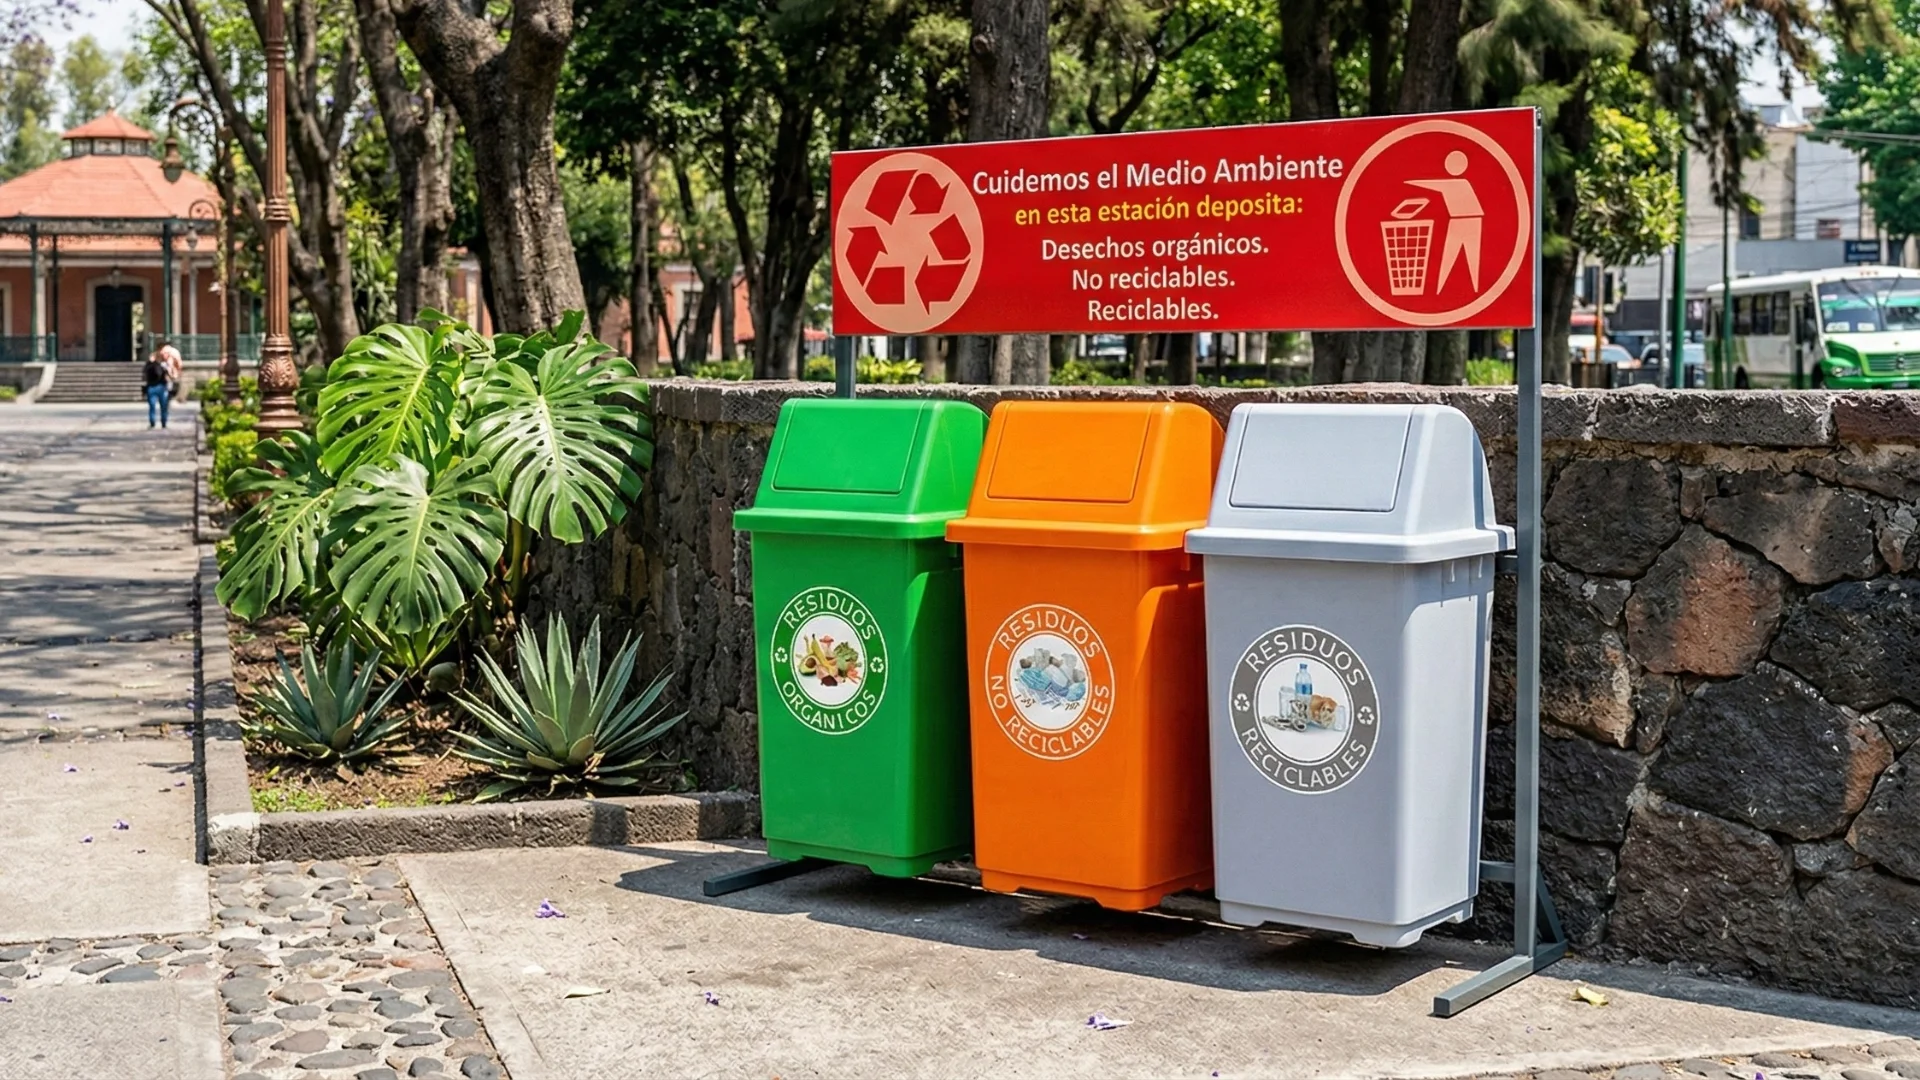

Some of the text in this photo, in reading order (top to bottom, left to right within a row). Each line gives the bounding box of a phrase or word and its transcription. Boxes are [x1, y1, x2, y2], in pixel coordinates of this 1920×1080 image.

[973, 154, 1343, 195] Cuidemos el Medio Ambiente
[1015, 192, 1303, 226] en esta estación deposita:
[1042, 231, 1269, 262] Desechos orgánicos.
[1072, 264, 1235, 290] No reciclables.
[1088, 296, 1219, 321] Reciclables.
[783, 592, 876, 640] RESIDUOS
[998, 610, 1101, 658] RESIDUOS
[1245, 631, 1365, 686] RESIDUOS
[782, 681, 876, 730] ORGANICOS
[991, 675, 1110, 754] NO RECICLABLES
[1241, 727, 1367, 788] RECICLABLES
